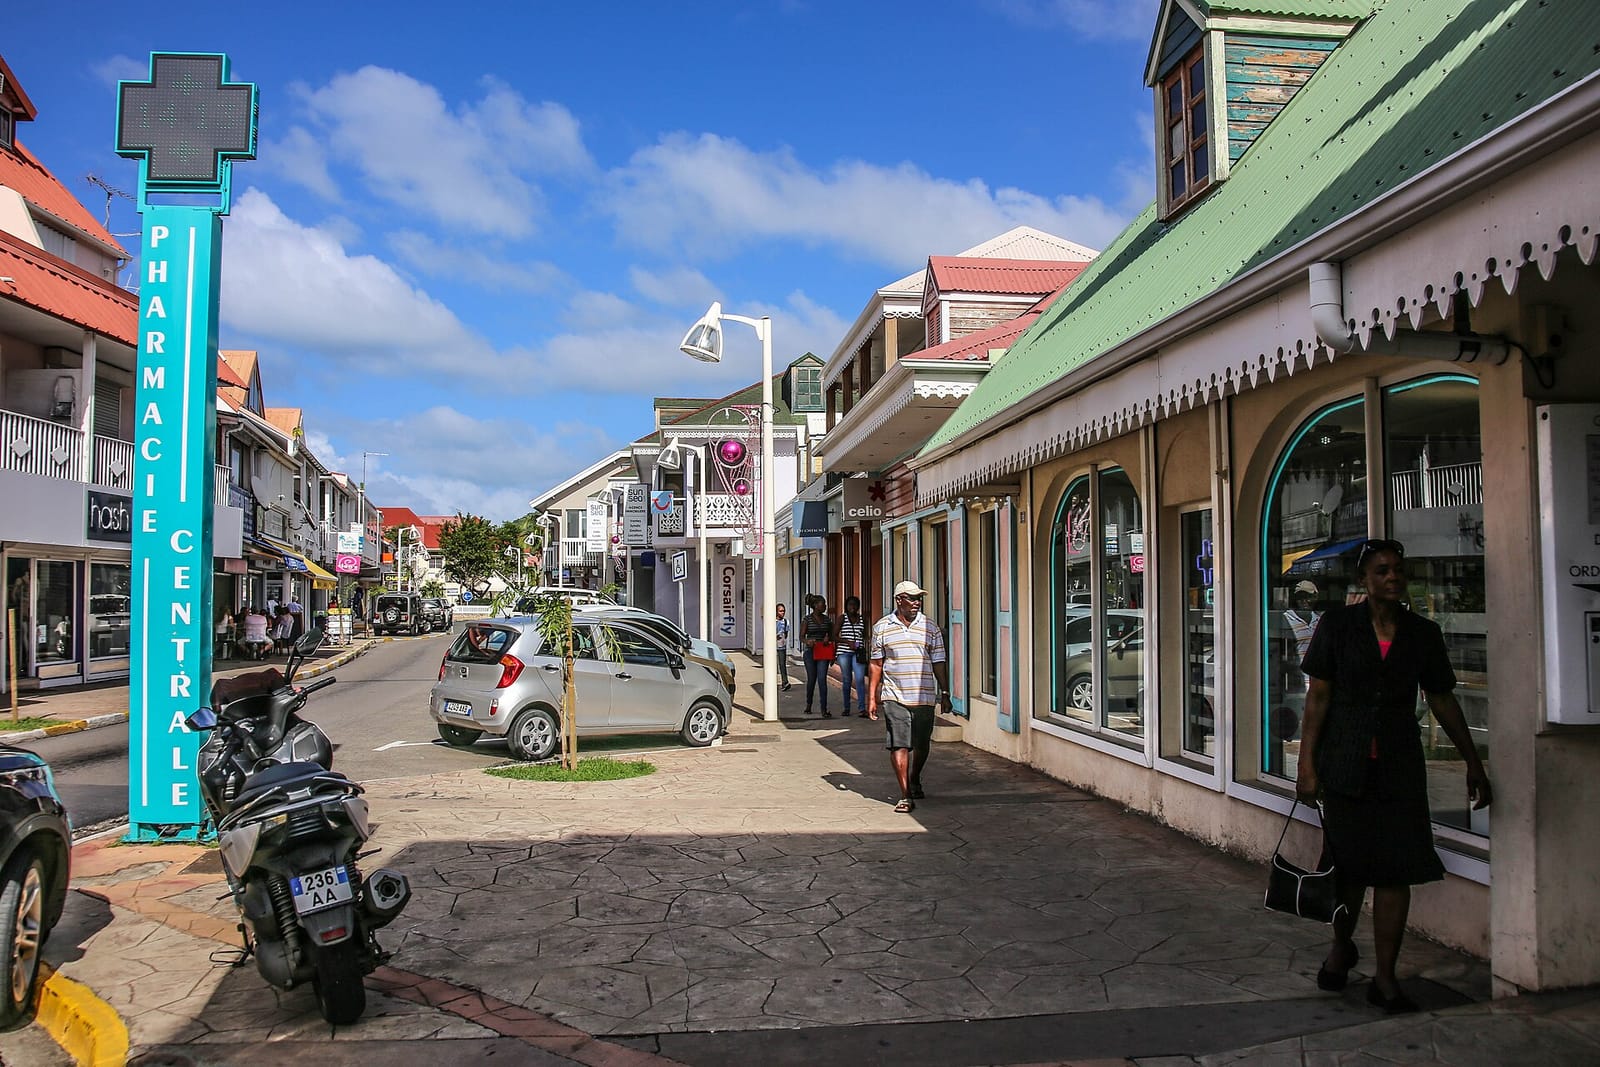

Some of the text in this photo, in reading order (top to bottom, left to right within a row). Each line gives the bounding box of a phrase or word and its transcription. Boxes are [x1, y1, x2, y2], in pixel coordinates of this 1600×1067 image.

[140, 225, 169, 533] PHARMACIE
[628, 488, 644, 496] sun
[90, 496, 129, 532] hash
[848, 505, 882, 517] celio
[720, 566, 735, 634] Corsairfly
[168, 529, 194, 806] CENTRALE
[304, 871, 335, 892] 236
[312, 888, 338, 907] AA
